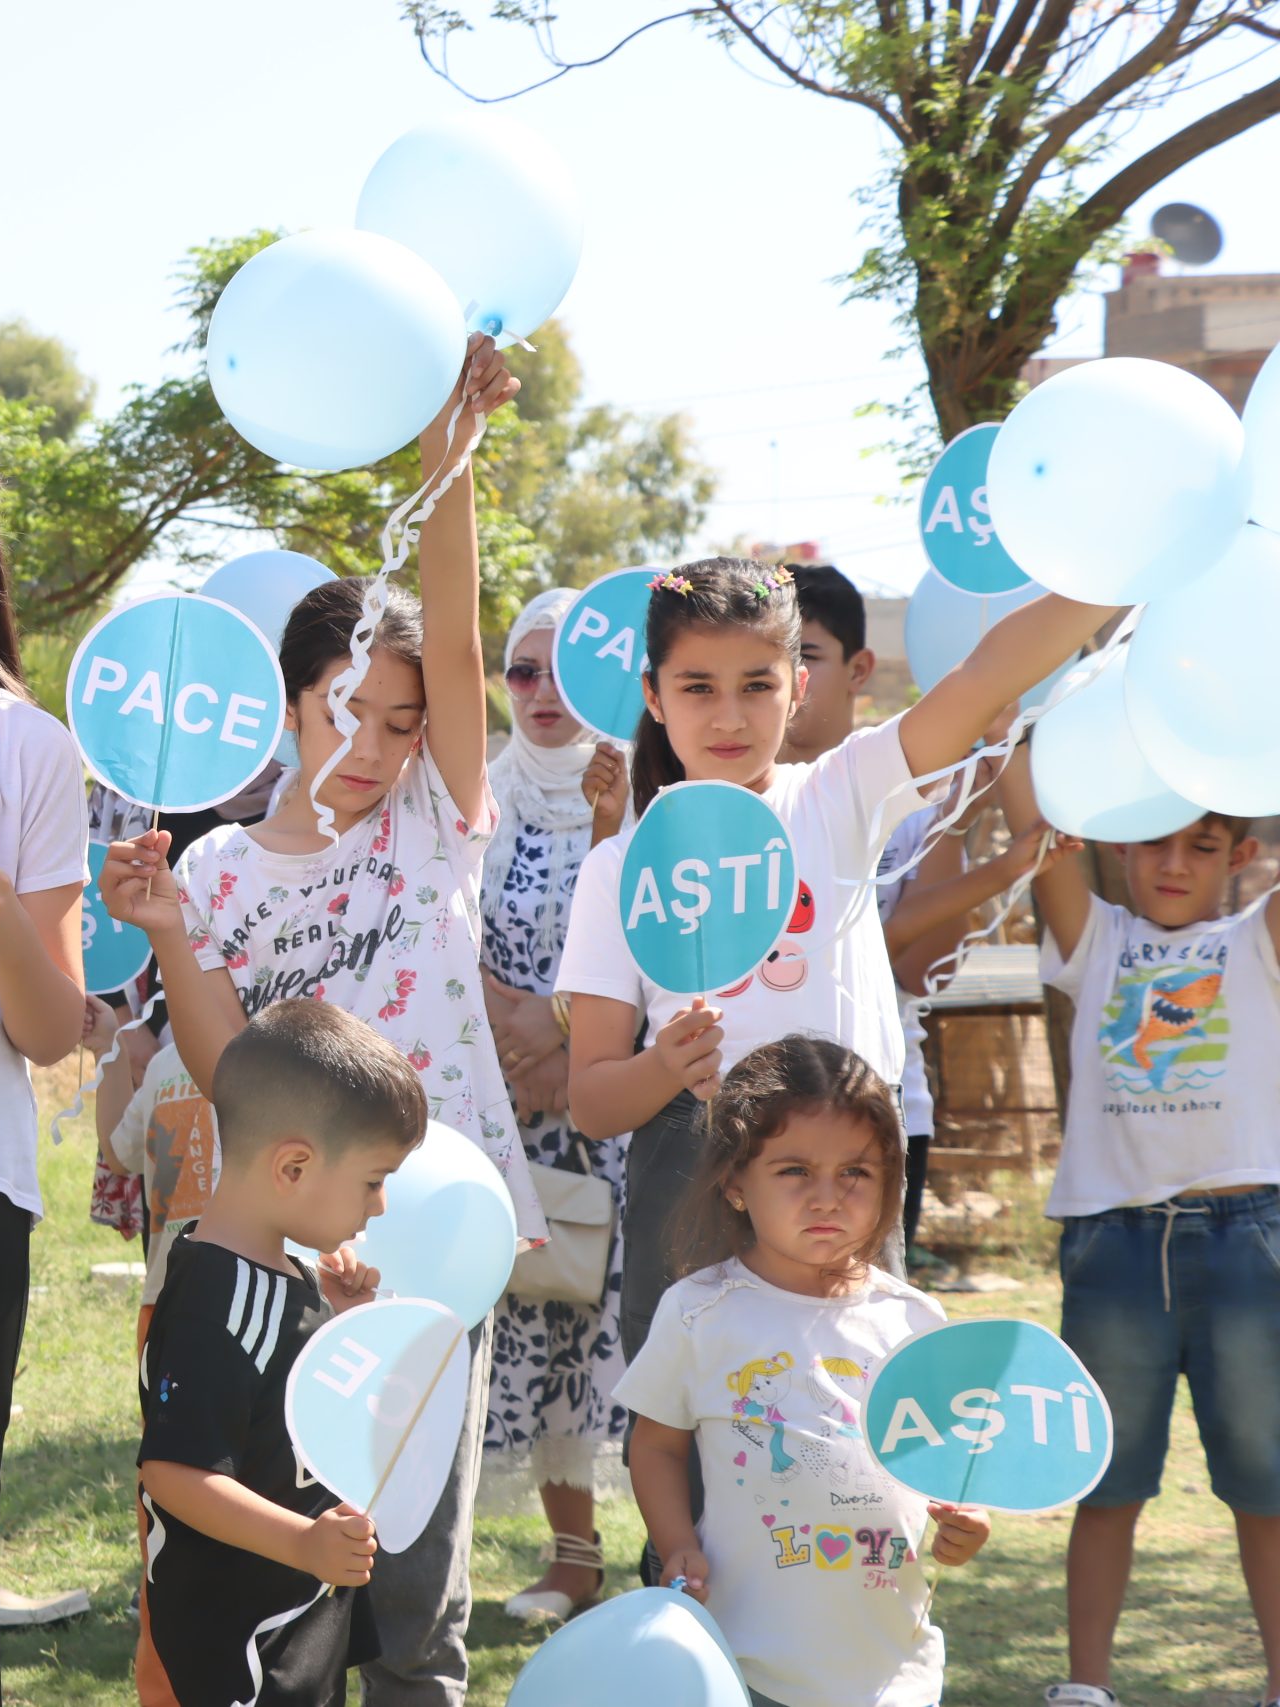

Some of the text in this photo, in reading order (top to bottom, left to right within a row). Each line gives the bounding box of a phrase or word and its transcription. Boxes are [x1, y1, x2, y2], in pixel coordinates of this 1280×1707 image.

[924, 486, 994, 546] AŞ
[568, 606, 650, 672] PA
[82, 655, 267, 749] PACE
[223, 902, 272, 960] MAKE
[366, 857, 394, 881] DA
[626, 837, 787, 934] AŞTÎ
[274, 921, 337, 955] REAL
[880, 1381, 1093, 1454] AŞTÎ
